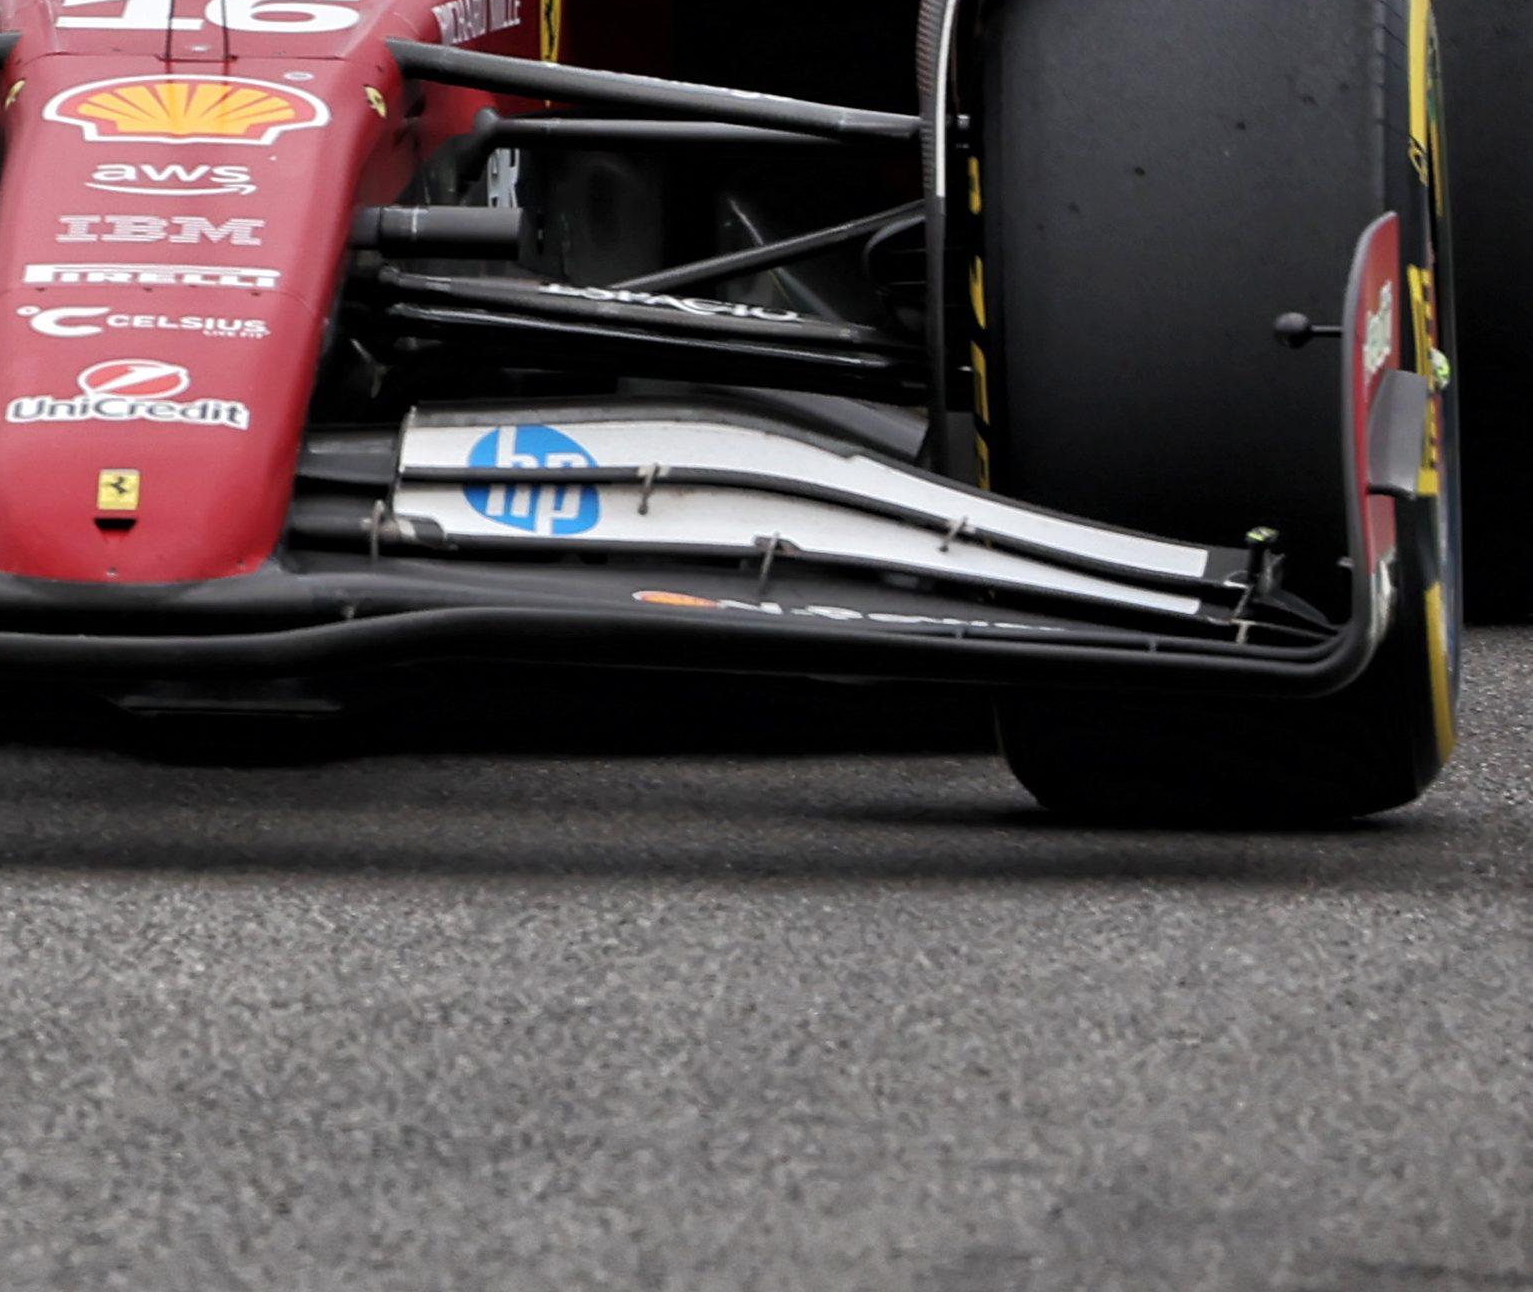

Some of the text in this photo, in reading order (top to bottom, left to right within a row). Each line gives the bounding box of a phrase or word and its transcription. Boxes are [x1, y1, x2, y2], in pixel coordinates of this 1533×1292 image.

[91, 163, 252, 183] aws
[55, 214, 266, 246] IBM
[22, 263, 281, 288] PIRELLI
[105, 314, 269, 333] CELSIUS
[7, 395, 249, 428] UniCredit
[478, 423, 595, 536] hp
